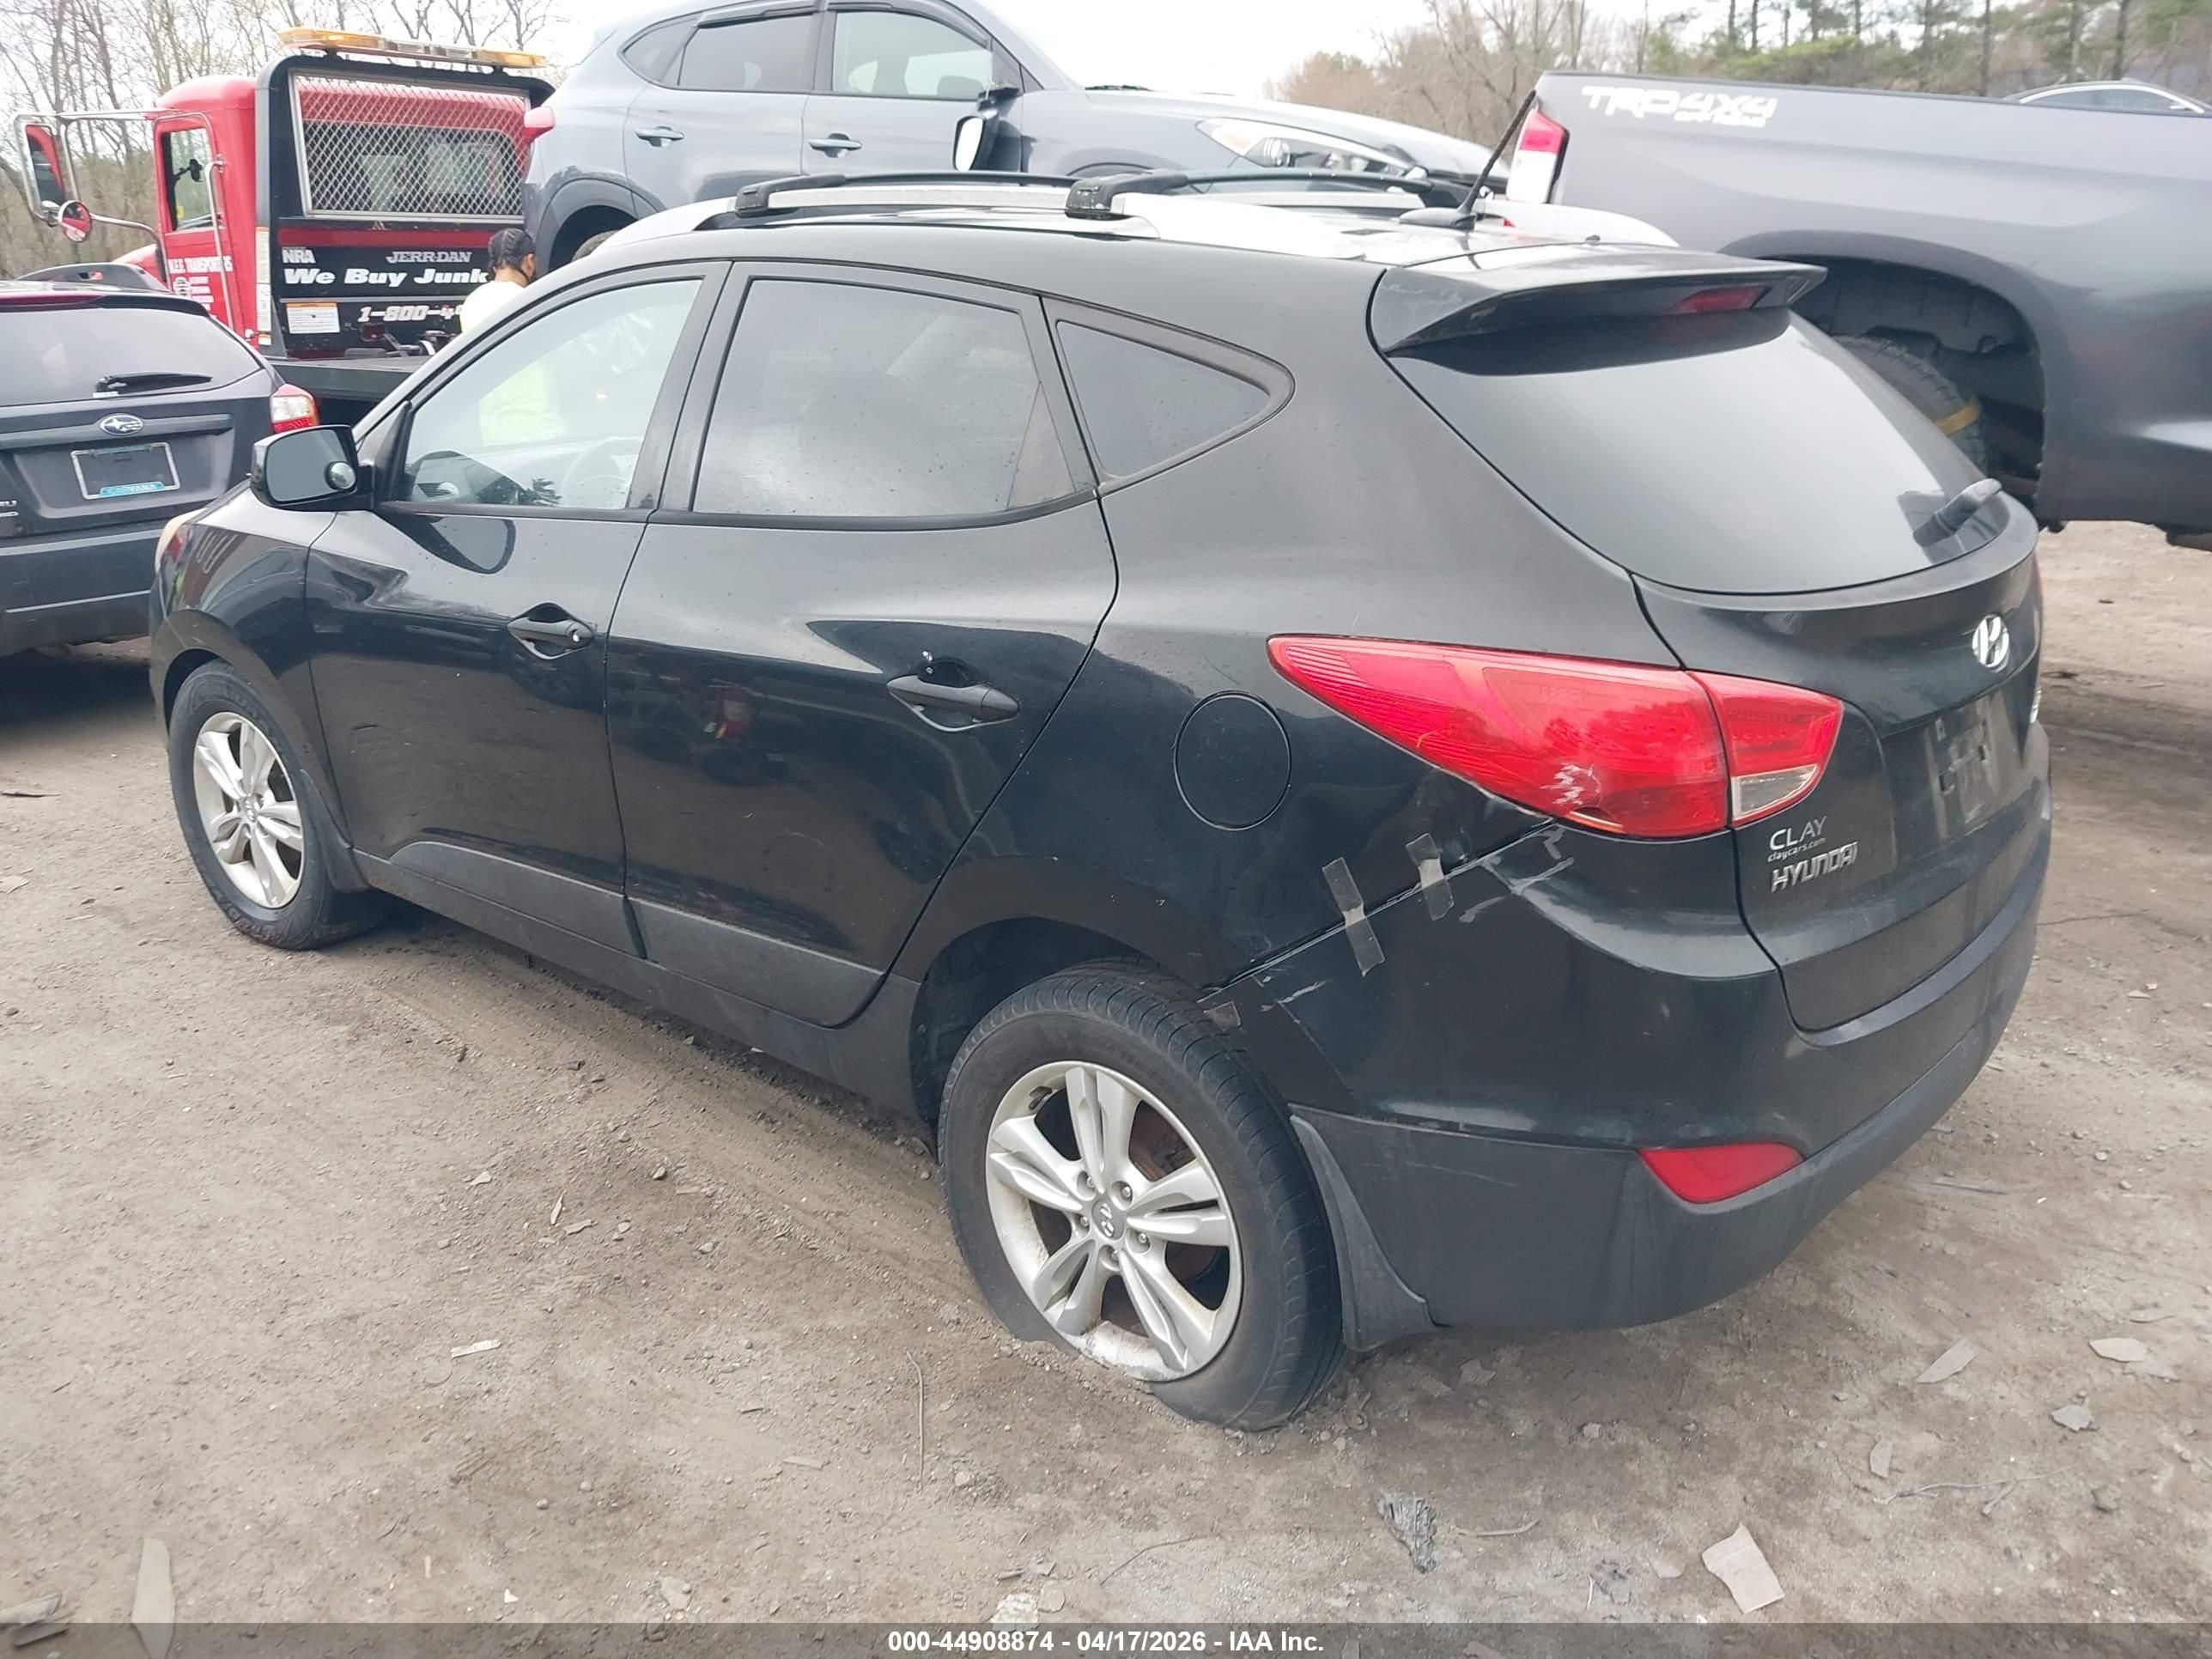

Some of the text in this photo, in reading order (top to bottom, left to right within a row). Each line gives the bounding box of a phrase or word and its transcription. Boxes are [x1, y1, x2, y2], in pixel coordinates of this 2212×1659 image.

[1582, 86, 1680, 118] TRD
[282, 248, 317, 264] NRA
[284, 268, 489, 288] We Buy Junk
[1769, 816, 1827, 851] CLAY
[1766, 837, 1827, 863] claycars.com
[1770, 841, 1859, 893] HYUNDAI
